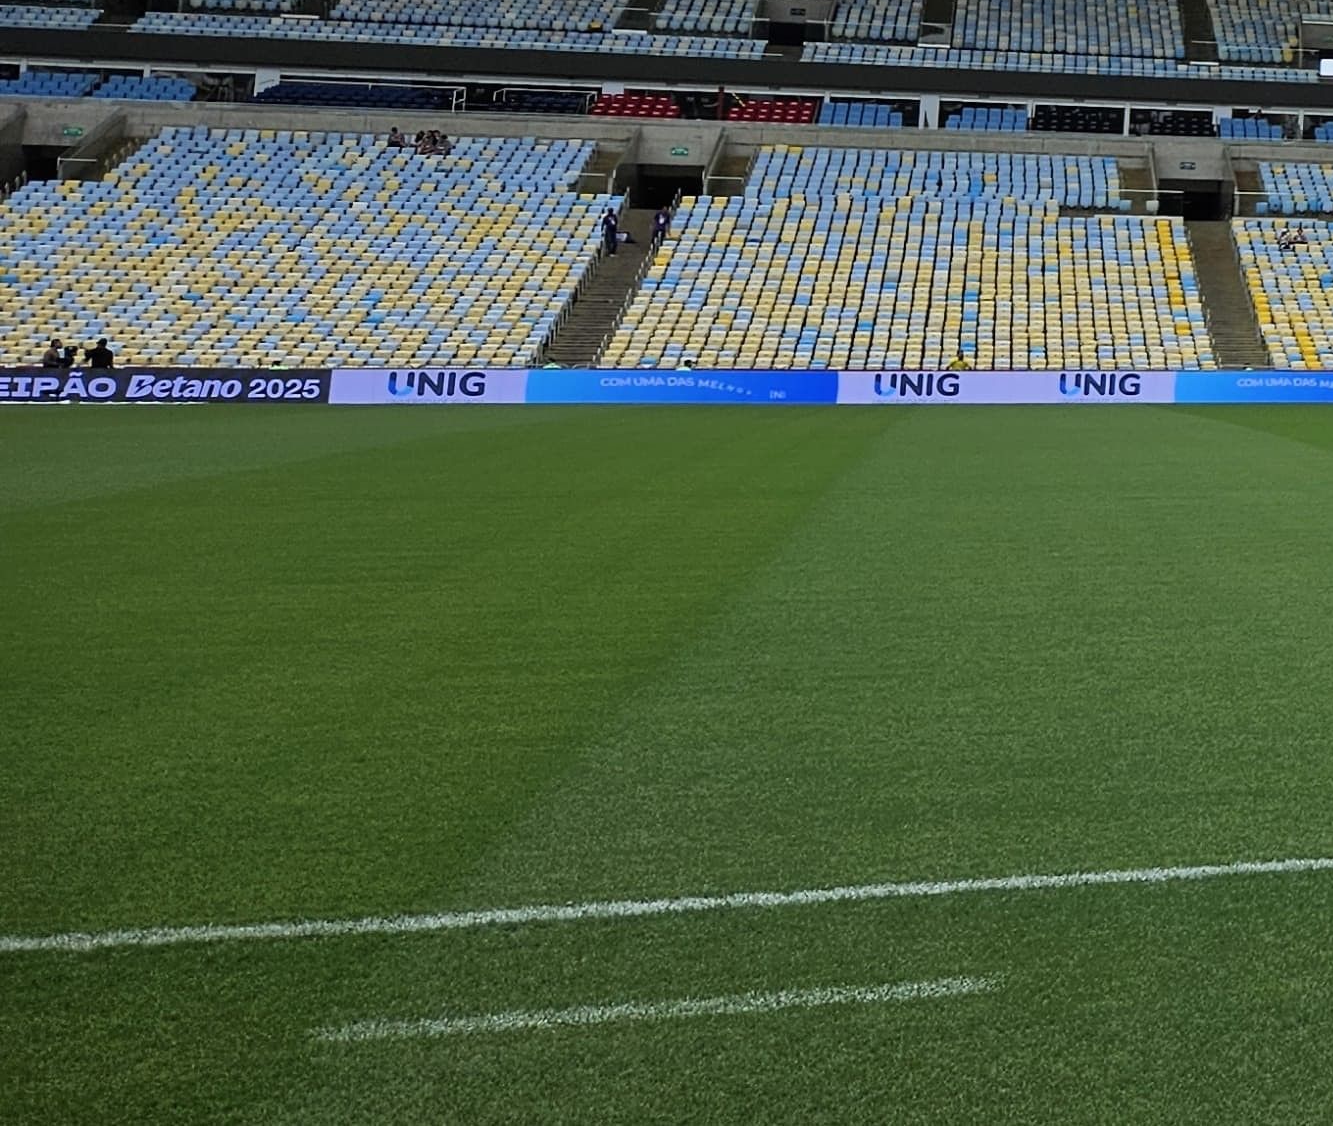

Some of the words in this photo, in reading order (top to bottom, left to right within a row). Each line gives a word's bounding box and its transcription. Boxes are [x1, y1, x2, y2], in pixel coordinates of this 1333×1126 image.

[125, 375, 242, 398] Betano
[248, 378, 320, 399] 2025
[388, 371, 486, 396] UNIG
[600, 377, 631, 387] COM
[633, 377, 665, 387] UMA
[667, 377, 695, 387] DAS
[874, 373, 960, 397] UNIG
[1059, 373, 1141, 396] UNIG
